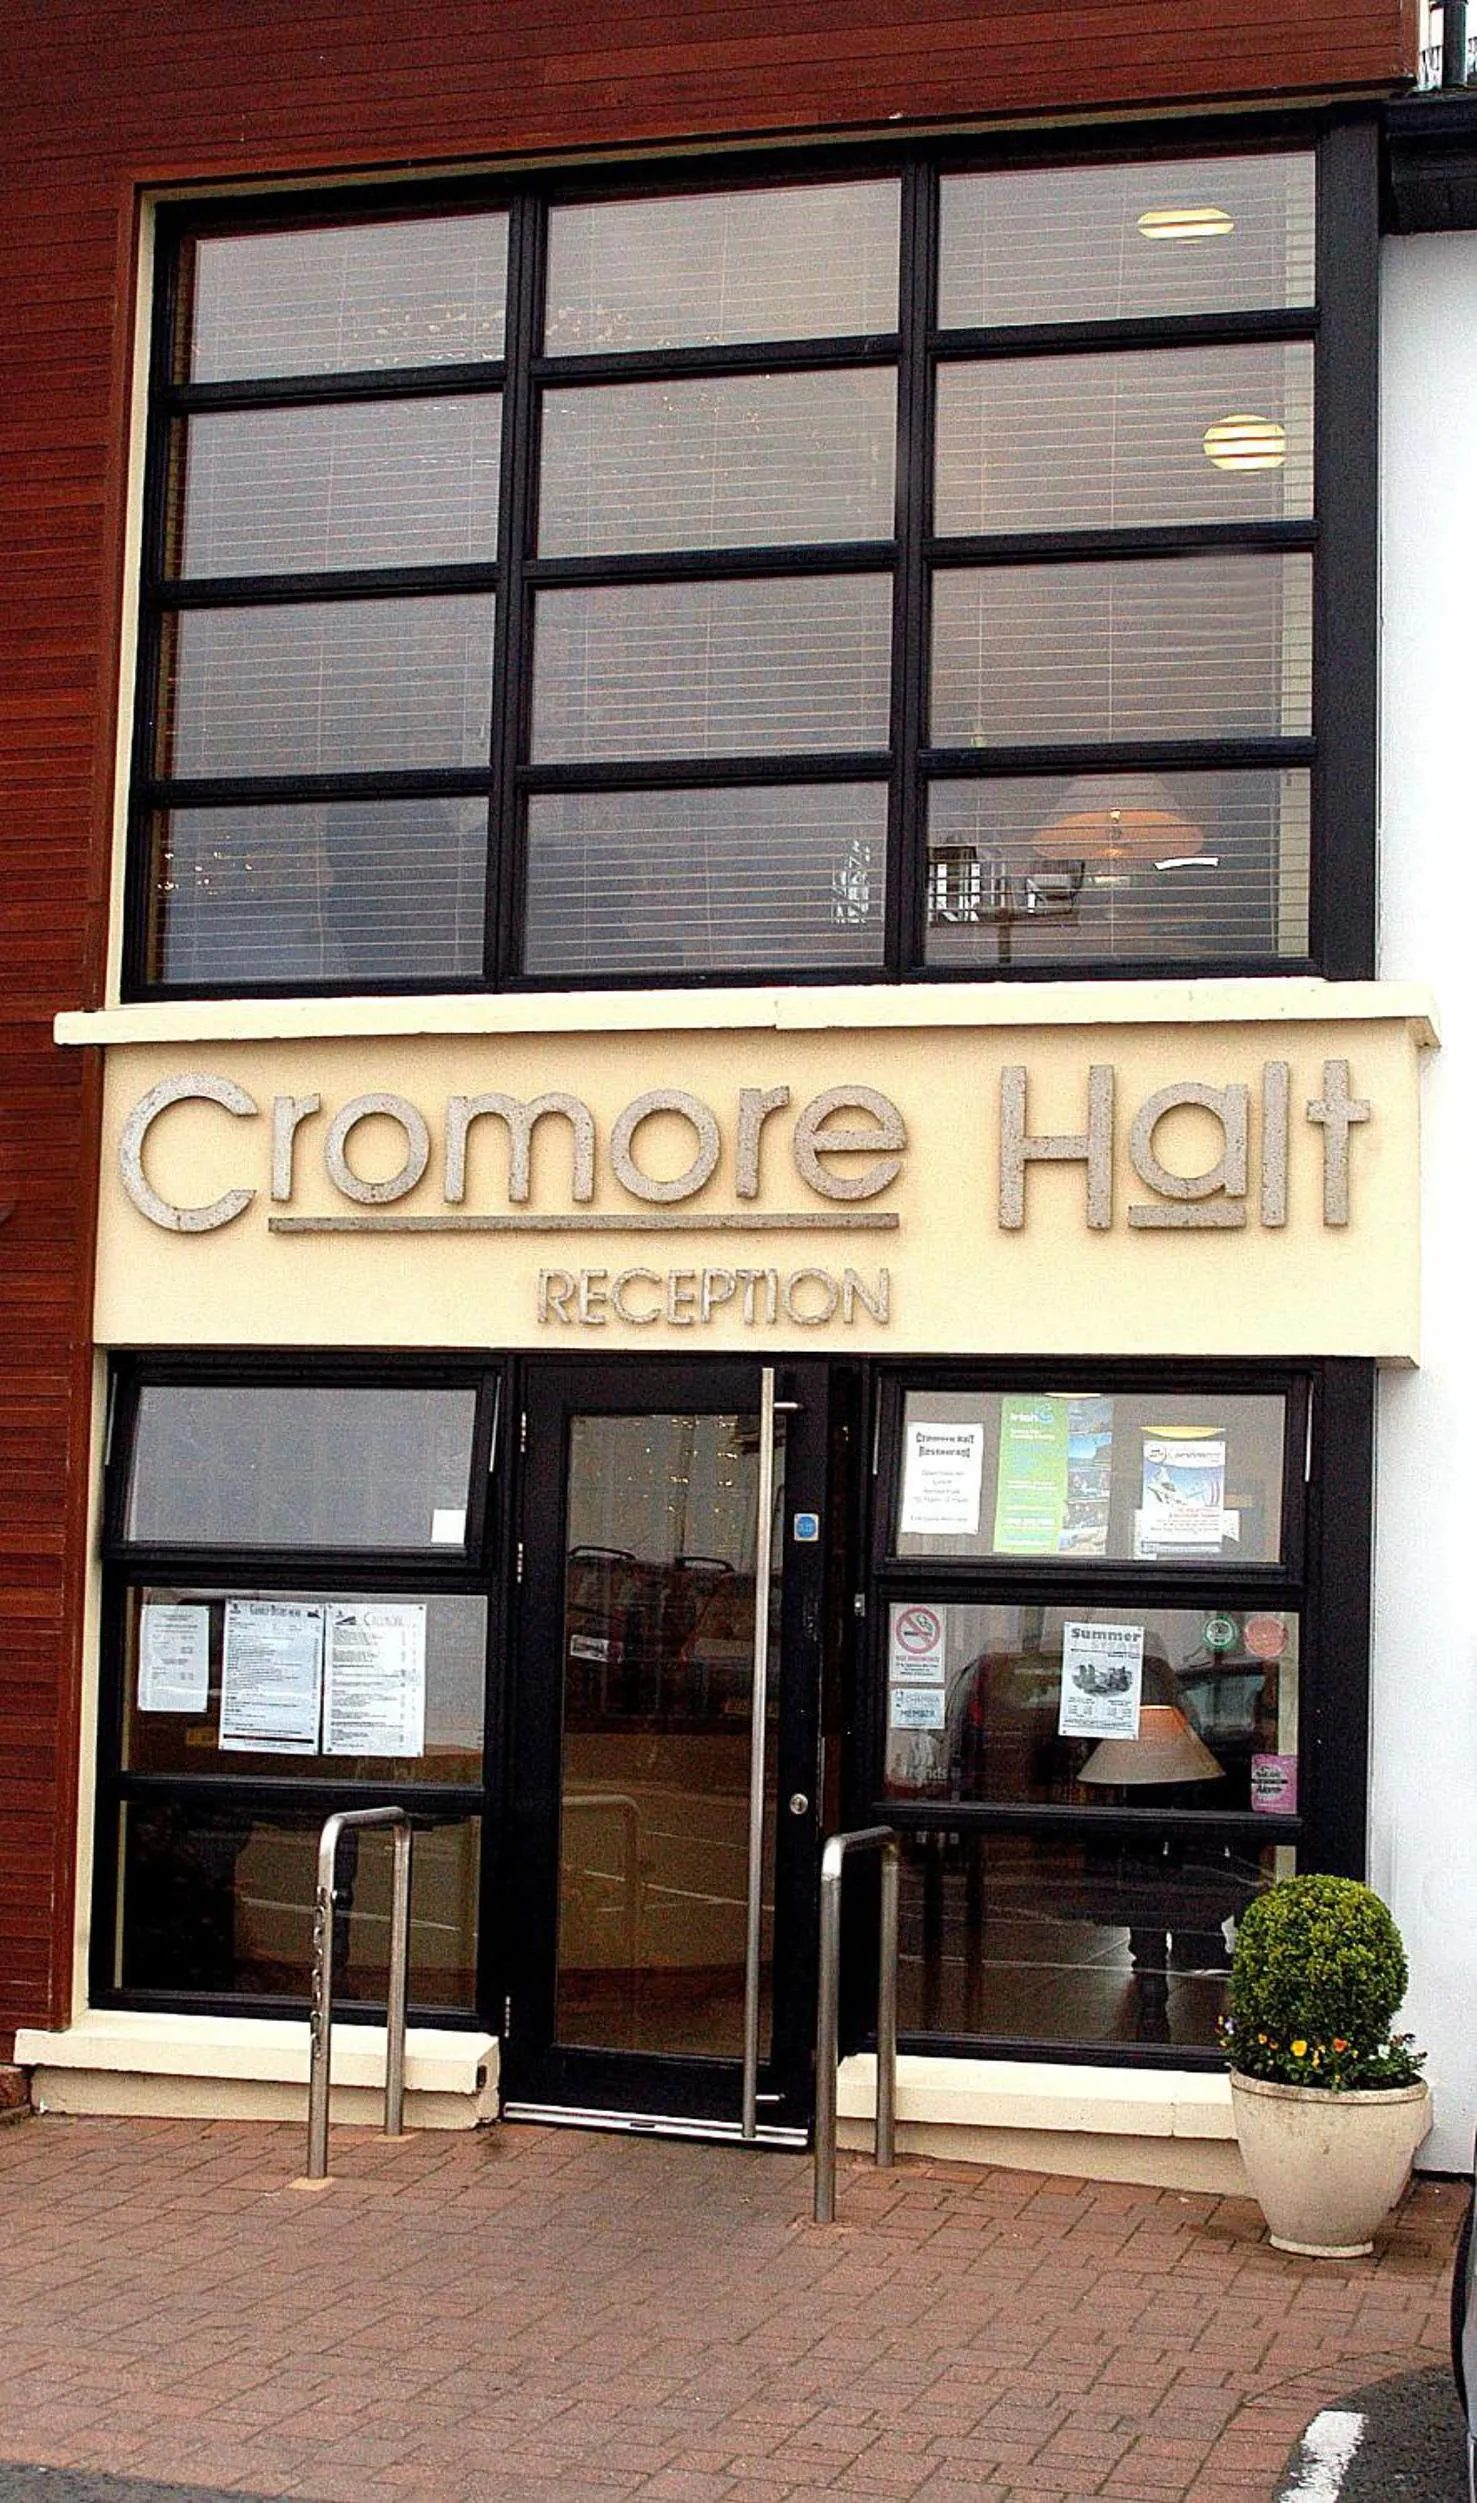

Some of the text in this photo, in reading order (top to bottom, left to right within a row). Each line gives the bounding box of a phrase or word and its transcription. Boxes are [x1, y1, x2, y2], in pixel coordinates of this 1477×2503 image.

[116, 1059, 1372, 1234] Cromore Halt
[537, 1267, 890, 1326] RECEPTION
[1071, 1628, 1141, 1642] Summer
